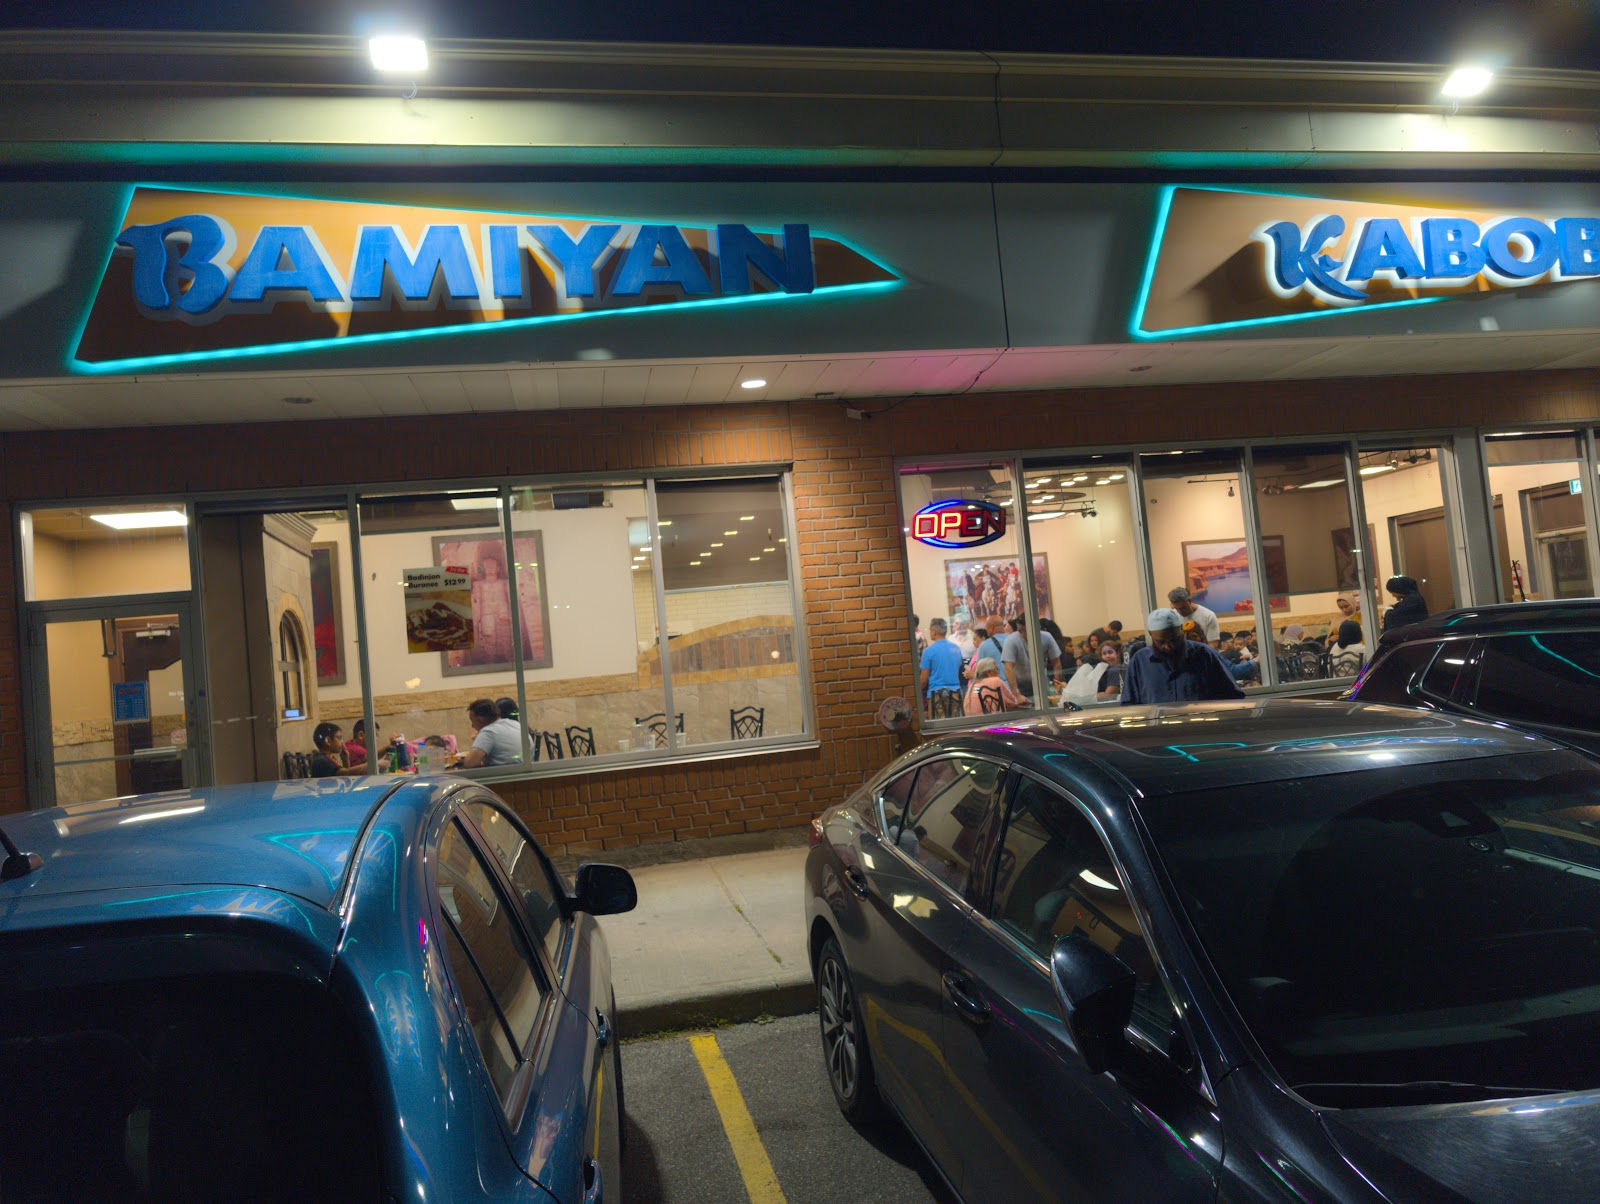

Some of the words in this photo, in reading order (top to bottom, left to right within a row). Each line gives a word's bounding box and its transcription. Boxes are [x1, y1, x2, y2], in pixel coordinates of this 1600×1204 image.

[115, 213, 814, 313] BAMIYAN
[1262, 214, 1600, 300] KABOB
[912, 508, 1006, 540] OPEN
